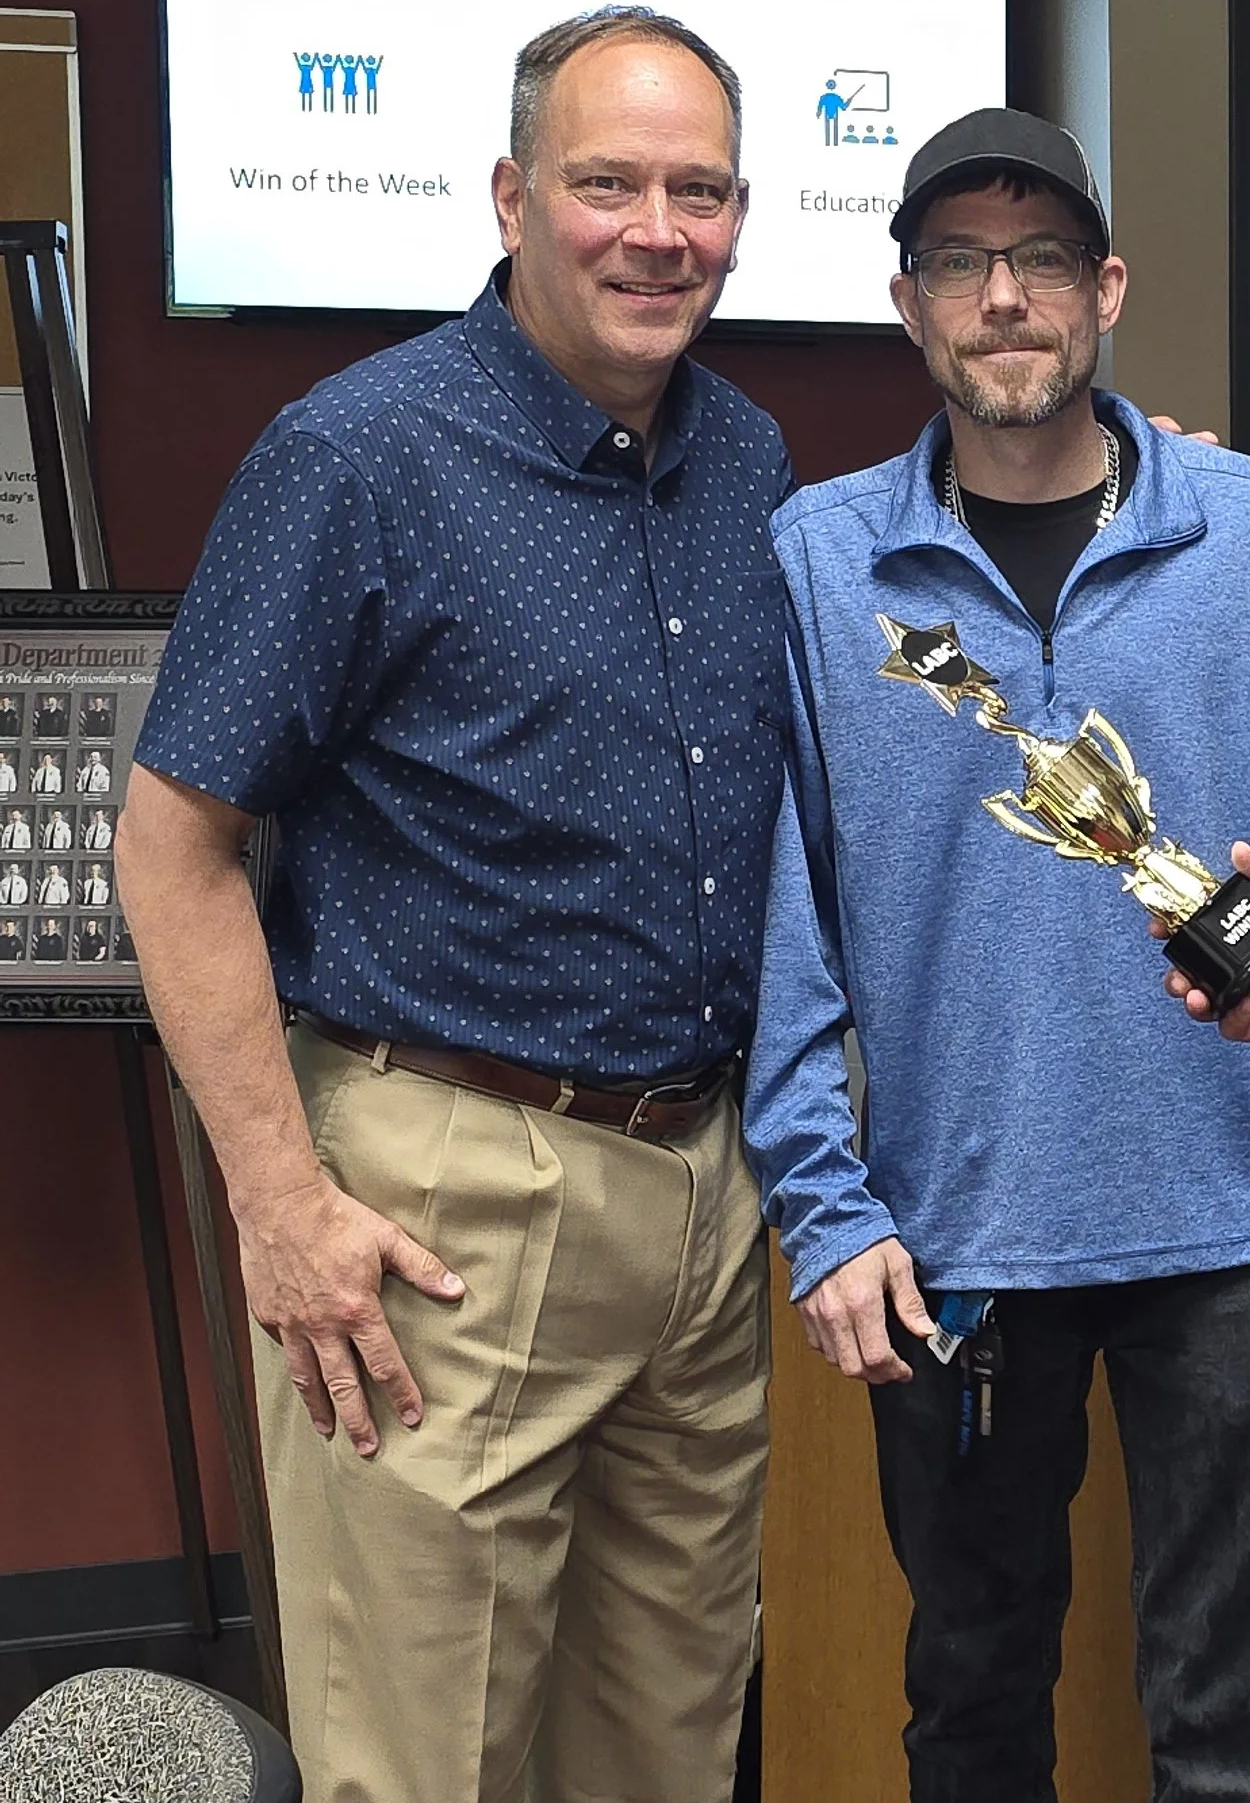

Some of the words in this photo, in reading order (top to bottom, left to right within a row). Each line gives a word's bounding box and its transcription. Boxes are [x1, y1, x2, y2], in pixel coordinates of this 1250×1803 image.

[229, 167, 282, 190] Win
[292, 168, 319, 192] of
[326, 170, 369, 194] the
[378, 173, 452, 197] Week
[800, 189, 901, 214] Educatio
[4, 471, 38, 482] Victo
[0, 491, 35, 504] day's
[1, 643, 147, 672] Department
[911, 641, 959, 676] LABC
[5, 670, 32, 684] Pride
[33, 670, 55, 684] and
[54, 670, 127, 689] Professionalism
